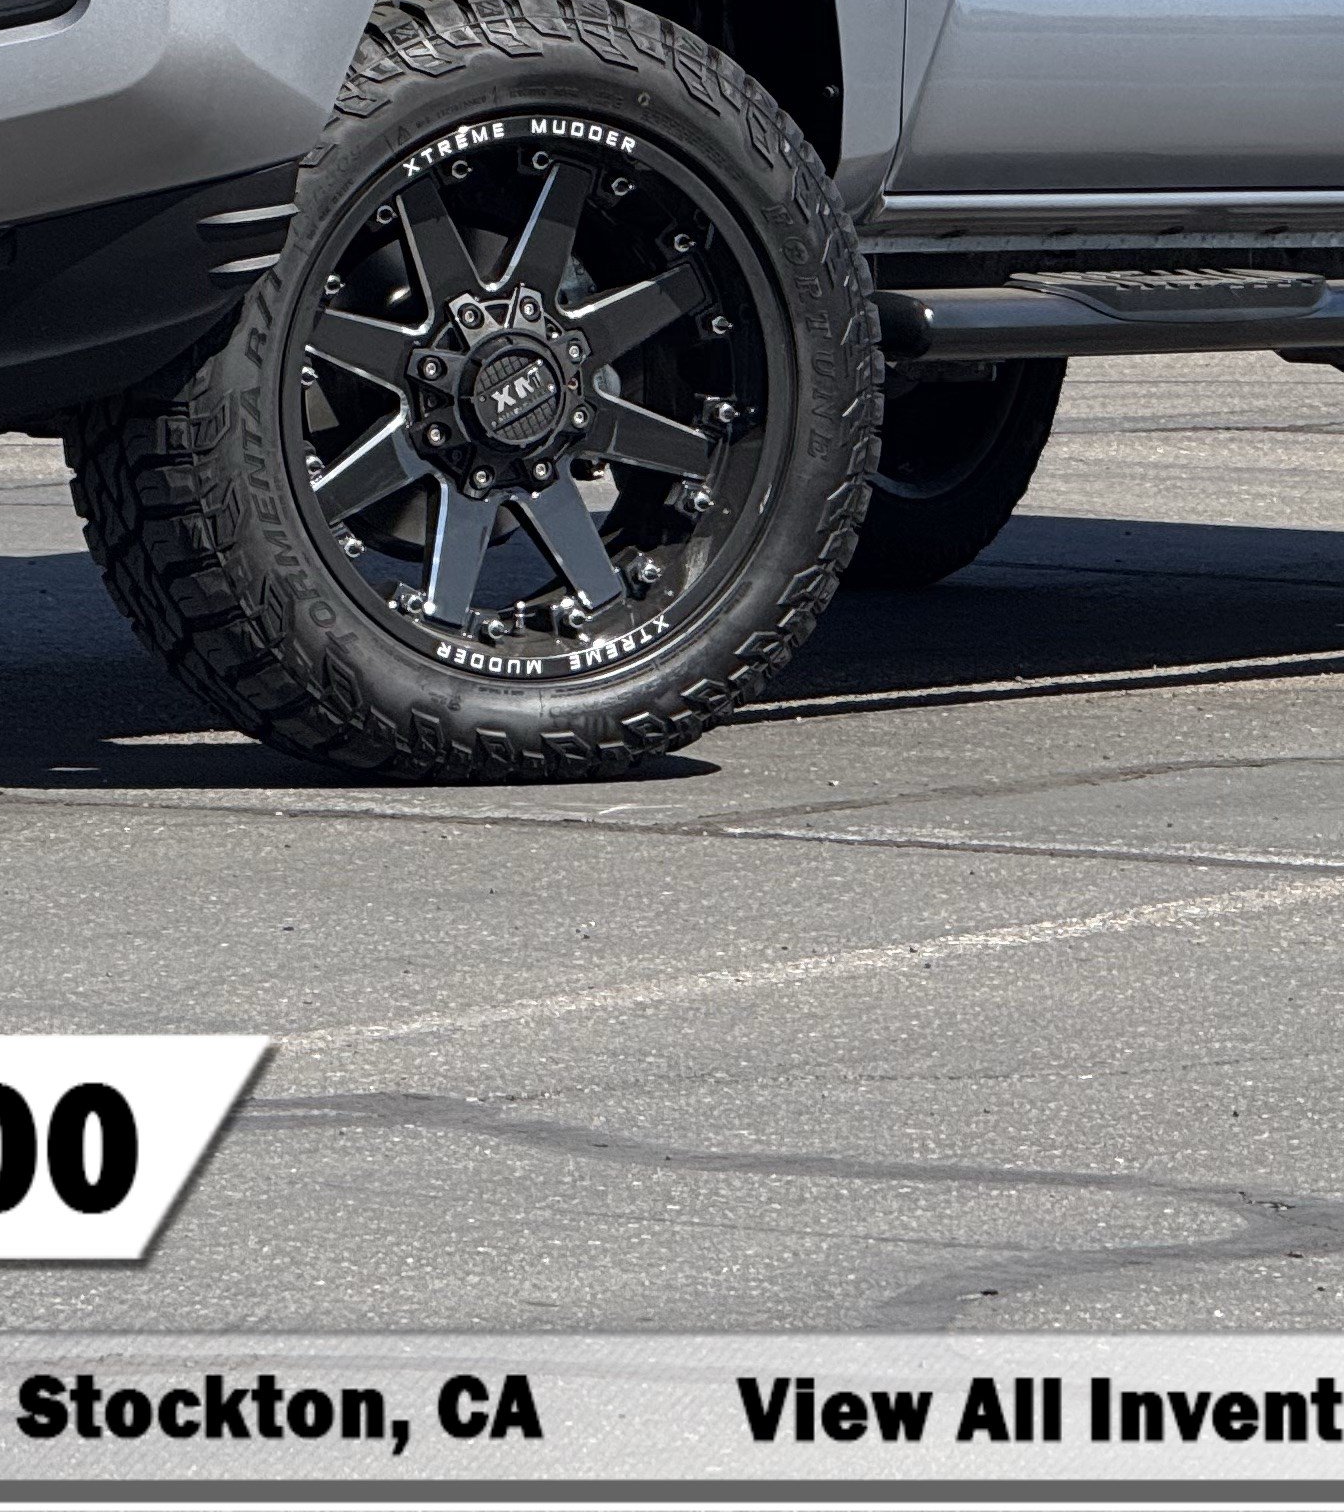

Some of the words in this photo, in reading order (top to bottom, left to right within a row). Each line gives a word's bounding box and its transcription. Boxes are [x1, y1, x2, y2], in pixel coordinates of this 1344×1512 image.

[403, 122, 505, 177] XTREME
[531, 118, 636, 154] MUDDER
[436, 641, 543, 675] MUDDER
[569, 614, 670, 671] XTREME
